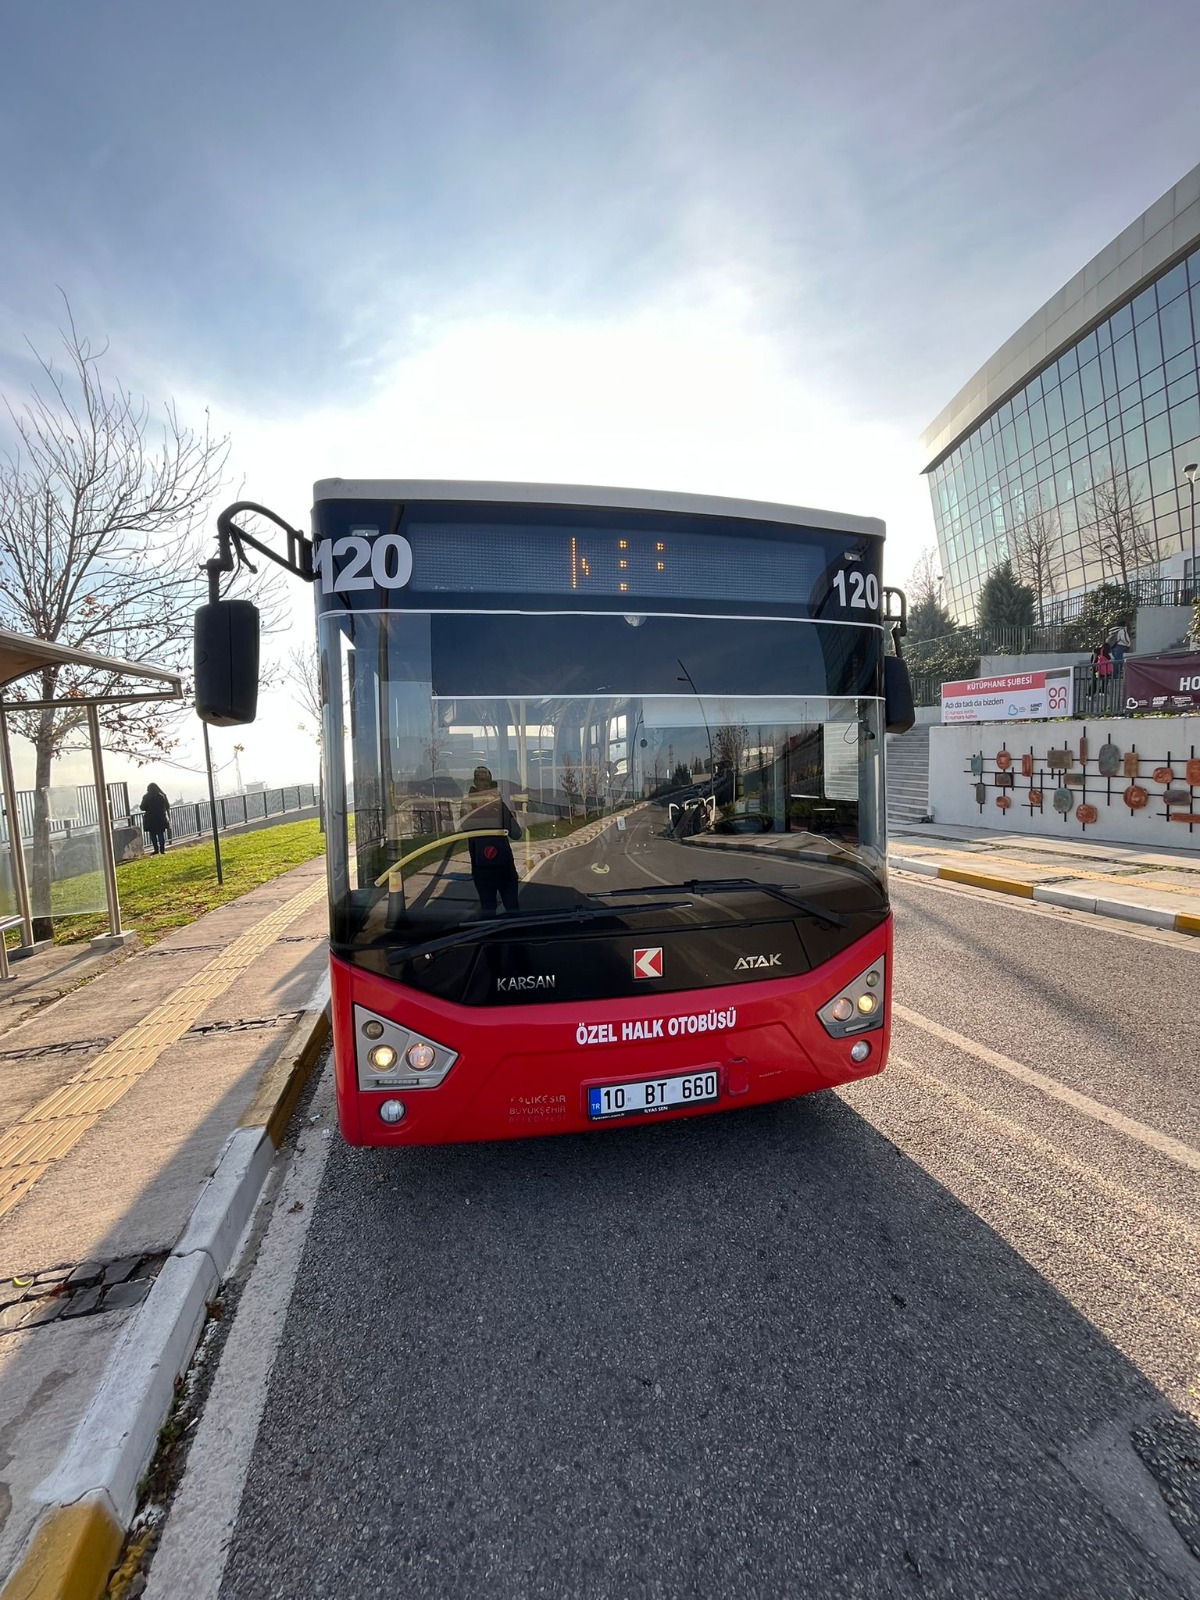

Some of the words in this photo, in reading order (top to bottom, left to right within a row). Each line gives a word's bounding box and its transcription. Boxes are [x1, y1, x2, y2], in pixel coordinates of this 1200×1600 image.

[312, 533, 413, 595] 120
[833, 570, 879, 610] 120
[966, 679, 1006, 691] KÜTÜPHANE
[1007, 675, 1033, 688] ŞUBESİ
[974, 699, 982, 707] da
[983, 697, 1004, 706] bizden
[733, 953, 782, 971] ATAK
[497, 974, 556, 991] KARSAN
[576, 1022, 618, 1045] ÖZEL
[622, 1017, 664, 1041] HALK
[668, 1006, 737, 1036] OTOBÜSÜ
[603, 1088, 625, 1110] 10
[645, 1082, 668, 1105] BT
[682, 1075, 715, 1099] 660
[591, 1102, 601, 1110] TR
